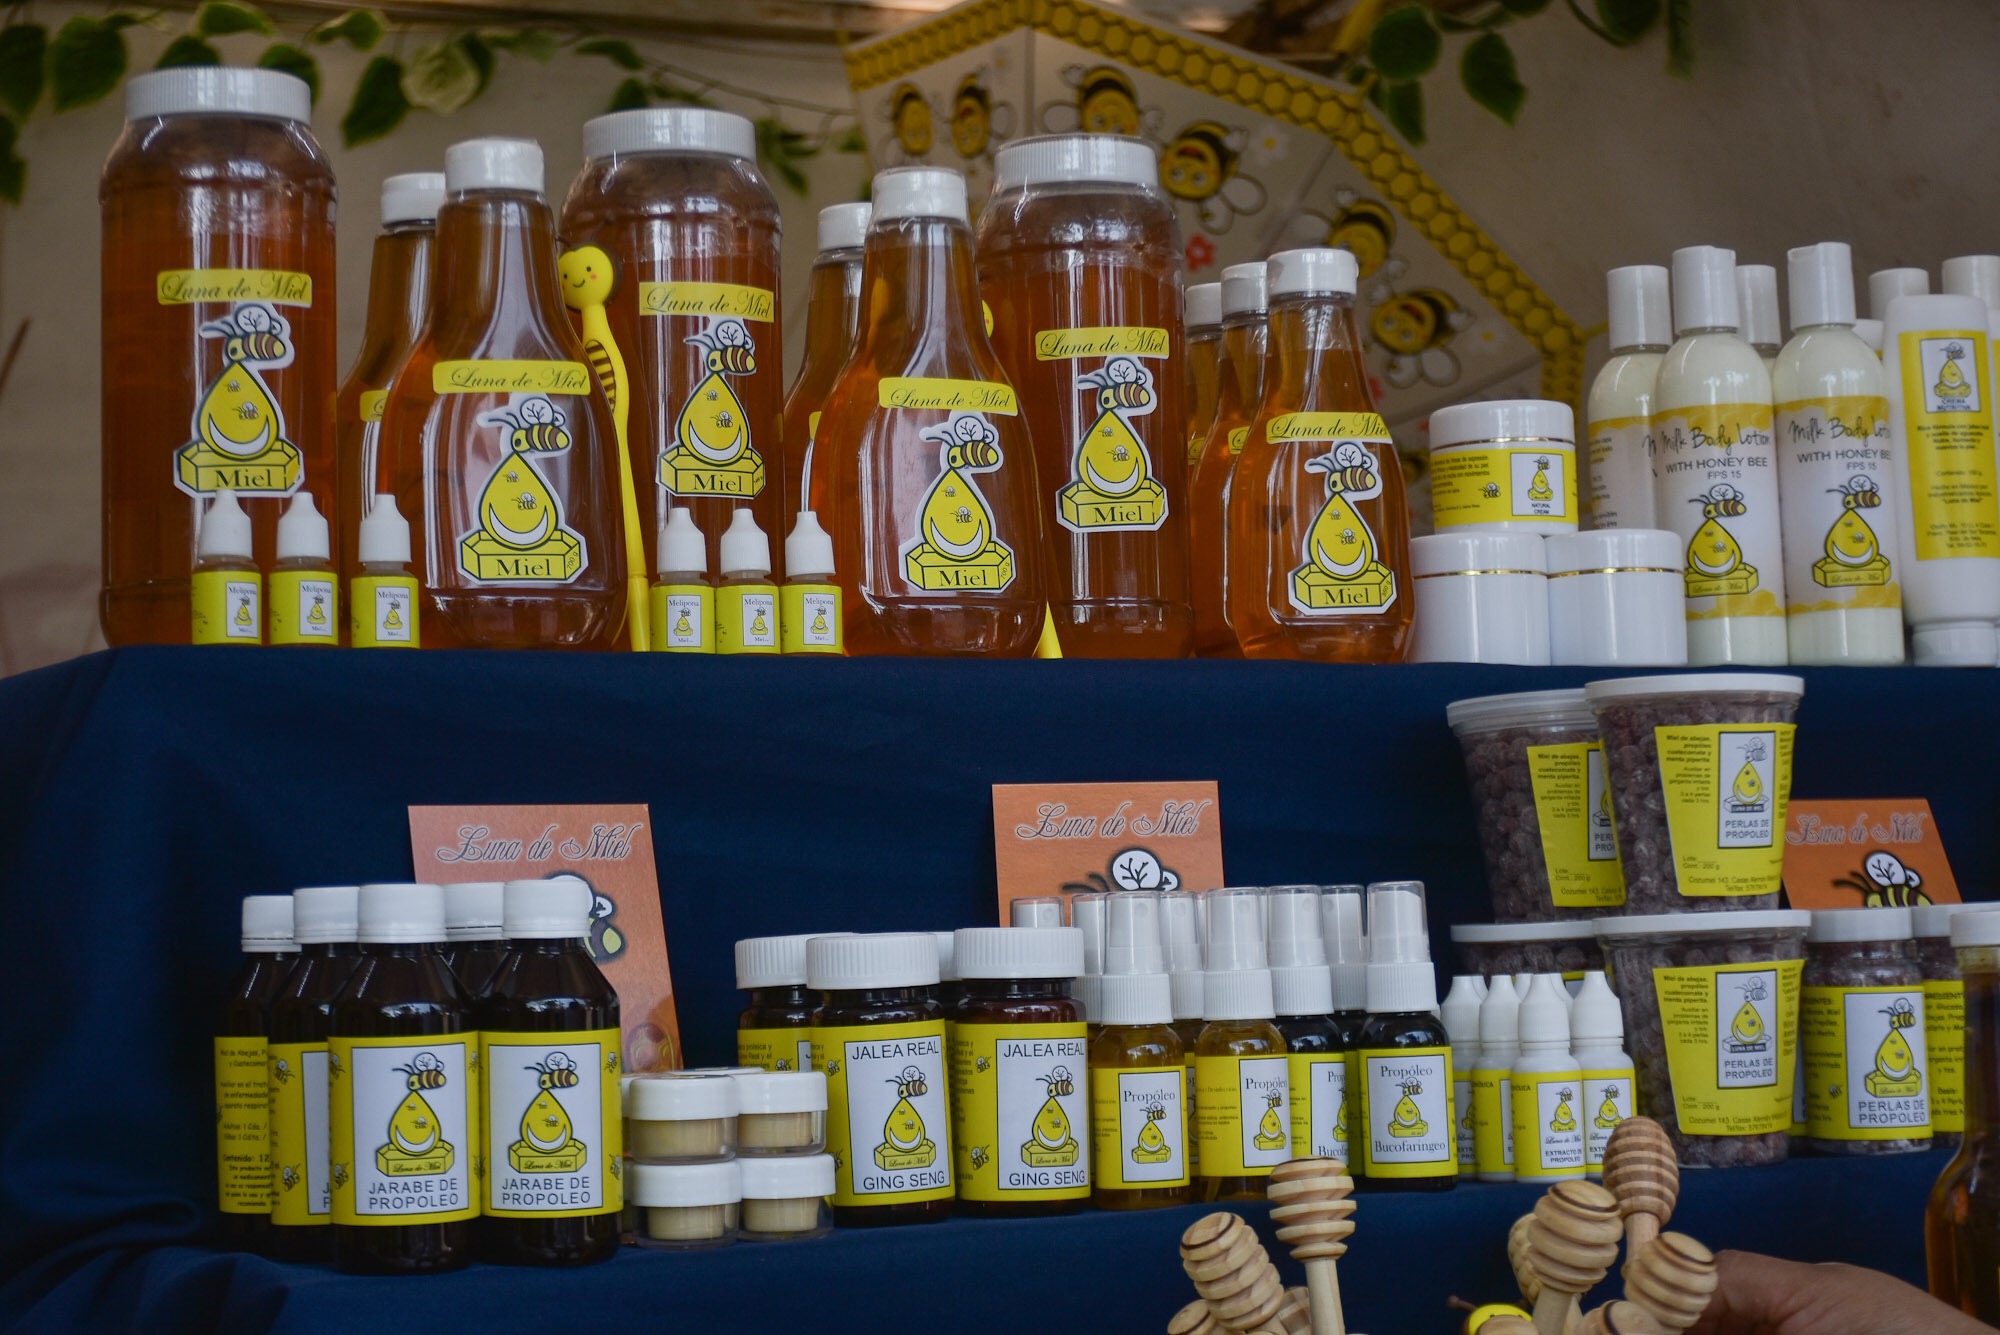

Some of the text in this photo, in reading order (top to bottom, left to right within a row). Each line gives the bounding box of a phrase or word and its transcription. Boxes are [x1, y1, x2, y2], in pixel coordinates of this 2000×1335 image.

[161, 272, 309, 300] Luna de Miel
[643, 286, 772, 318] Luna de Miel
[1037, 328, 1166, 358] Luna de Miel
[450, 366, 586, 389] Luna de Miel
[889, 386, 1010, 408] Luna de Miel
[1269, 416, 1322, 439] Luna
[1328, 419, 1346, 435] de
[1788, 417, 1825, 446] Milk
[1827, 417, 1871, 447] Body
[1661, 427, 1688, 450] Milk
[1690, 424, 1733, 455] Body
[1665, 456, 1768, 474] WITH HONEY BEE
[1797, 452, 1831, 463] WITH
[1835, 450, 1879, 461] HONEY
[1846, 461, 1866, 471] FPS
[216, 469, 272, 488] Miel
[693, 474, 743, 492] Miel
[1707, 470, 1742, 480] FPS 15
[1094, 506, 1143, 523] Miel
[496, 558, 552, 576] Miel
[939, 569, 987, 587] Miel
[668, 599, 699, 608] Melipona
[744, 598, 774, 607] Melipona
[805, 597, 834, 607] Melipona
[1323, 587, 1370, 605] Miel
[1015, 799, 1213, 841] Luna de Miel
[1725, 819, 1769, 828] PERLAS DE
[1849, 811, 1869, 845] de
[436, 822, 645, 862] Luna de Miel
[1726, 830, 1769, 839] PROPOLEO
[852, 1040, 939, 1061] JALEA REAL
[1003, 1042, 1085, 1058] JALEA REAL
[1724, 1058, 1773, 1068] PERLAS DE
[1381, 1065, 1433, 1079] Propóleo
[1725, 1068, 1772, 1079] PROPOLEO
[1124, 1089, 1175, 1104] Propóleo
[1858, 1100, 1925, 1113] PERLAS DE
[1859, 1112, 1926, 1124] PROPOLEO
[1545, 1149, 1576, 1157] EXTRACTO
[369, 1178, 458, 1195] JARABE DE
[502, 1176, 591, 1191] JARABE DE
[863, 1170, 945, 1191] GING SENG
[1009, 1170, 1085, 1187] GING SENG
[369, 1193, 459, 1209] PROPOLEO
[502, 1191, 591, 1206] PROPOLEO
